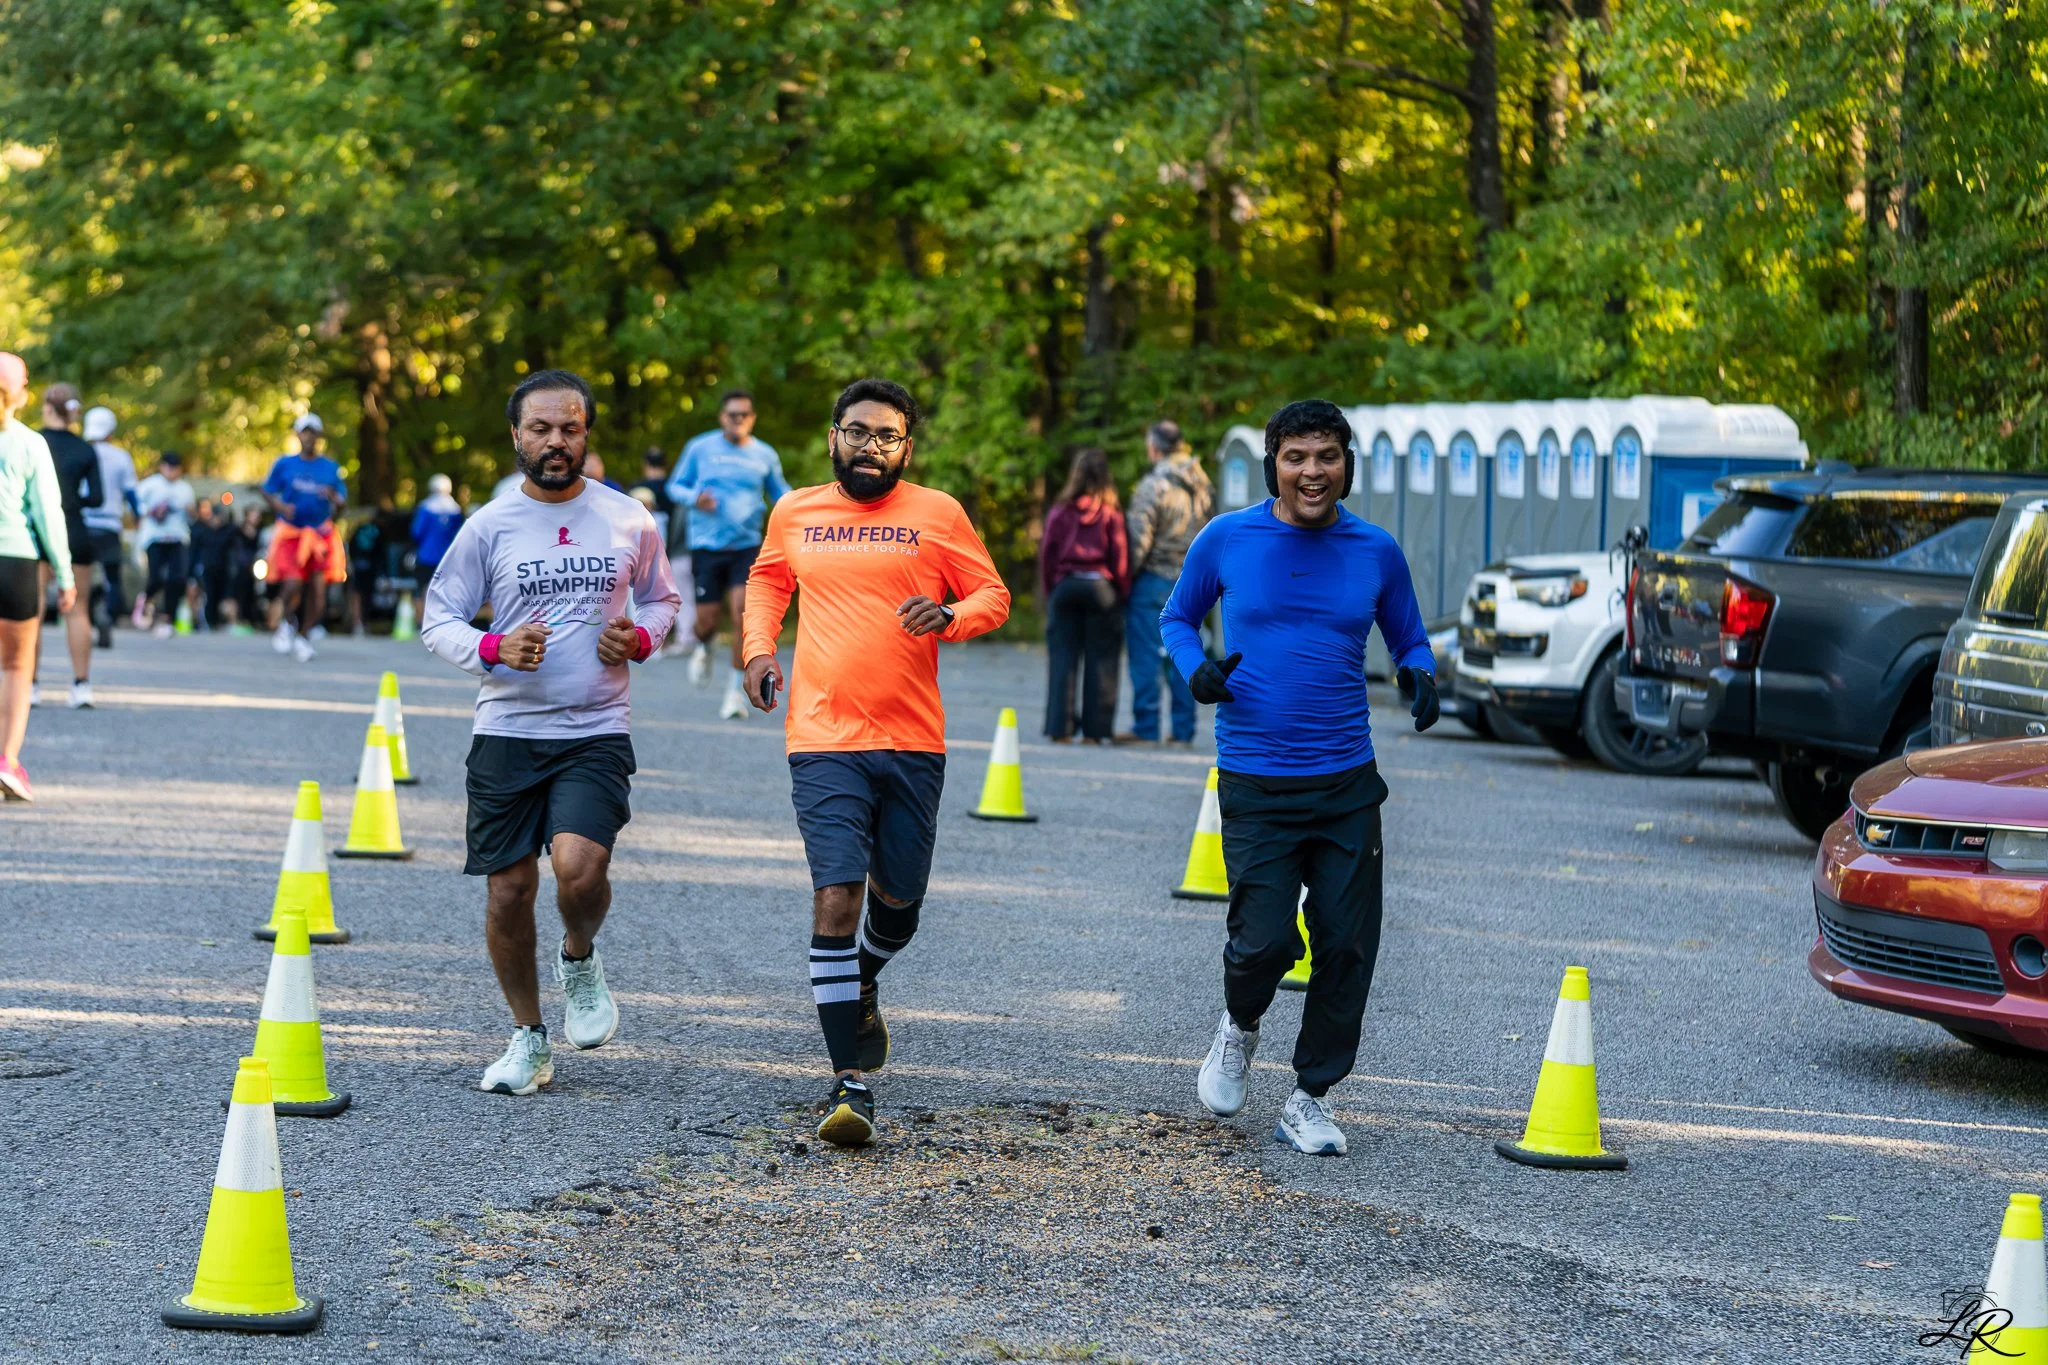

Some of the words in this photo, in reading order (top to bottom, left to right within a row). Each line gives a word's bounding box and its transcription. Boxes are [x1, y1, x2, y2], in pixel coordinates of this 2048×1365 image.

[804, 526, 855, 543] TEAM
[858, 526, 920, 546] FEDEX
[800, 545, 814, 554] NO
[816, 544, 870, 554] DISTANCE
[873, 544, 897, 554] TOO
[900, 546, 919, 558] FAR
[517, 559, 549, 579] ST.
[554, 556, 618, 574] JUDE
[518, 576, 617, 597] MEMPHIS
[572, 596, 612, 606] WEEKEND
[573, 608, 588, 616] 10K
[593, 608, 603, 616] 5K
